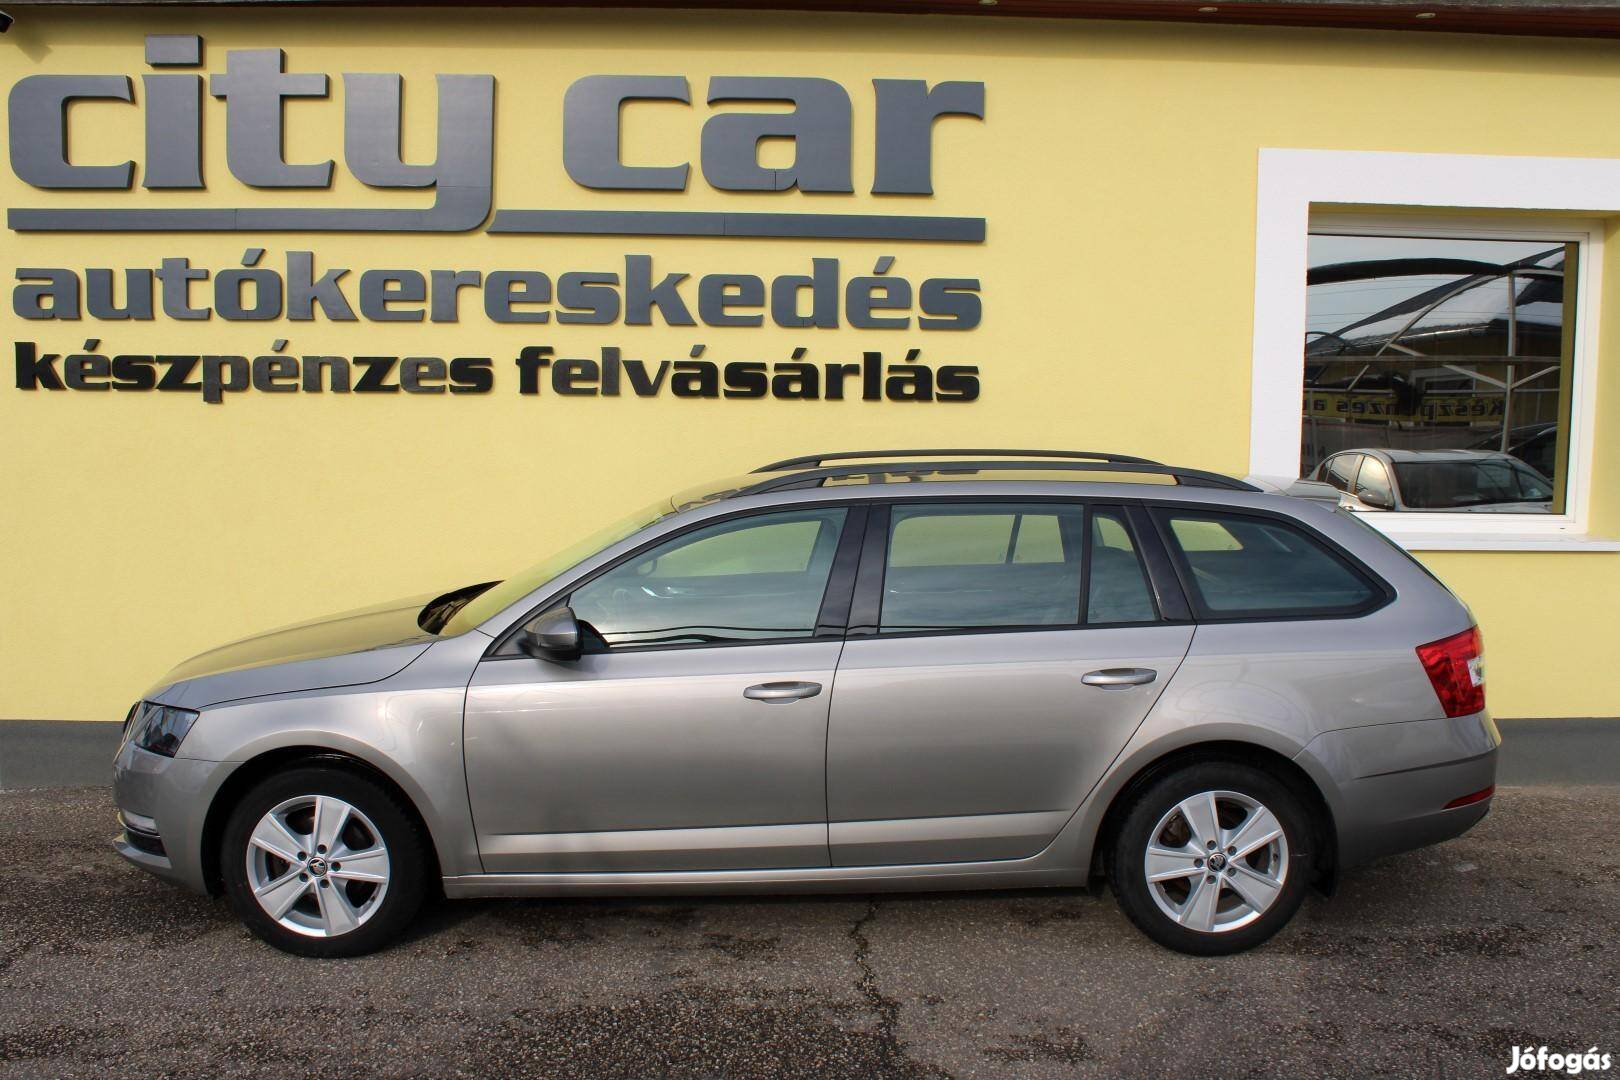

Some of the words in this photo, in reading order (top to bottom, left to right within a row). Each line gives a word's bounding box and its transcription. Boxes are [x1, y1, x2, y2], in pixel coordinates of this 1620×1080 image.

[8, 34, 496, 232] city
[562, 74, 985, 196] car
[13, 247, 982, 332] autókereskedés
[14, 338, 494, 404] készpénzes
[515, 344, 980, 403] felvásárlás
